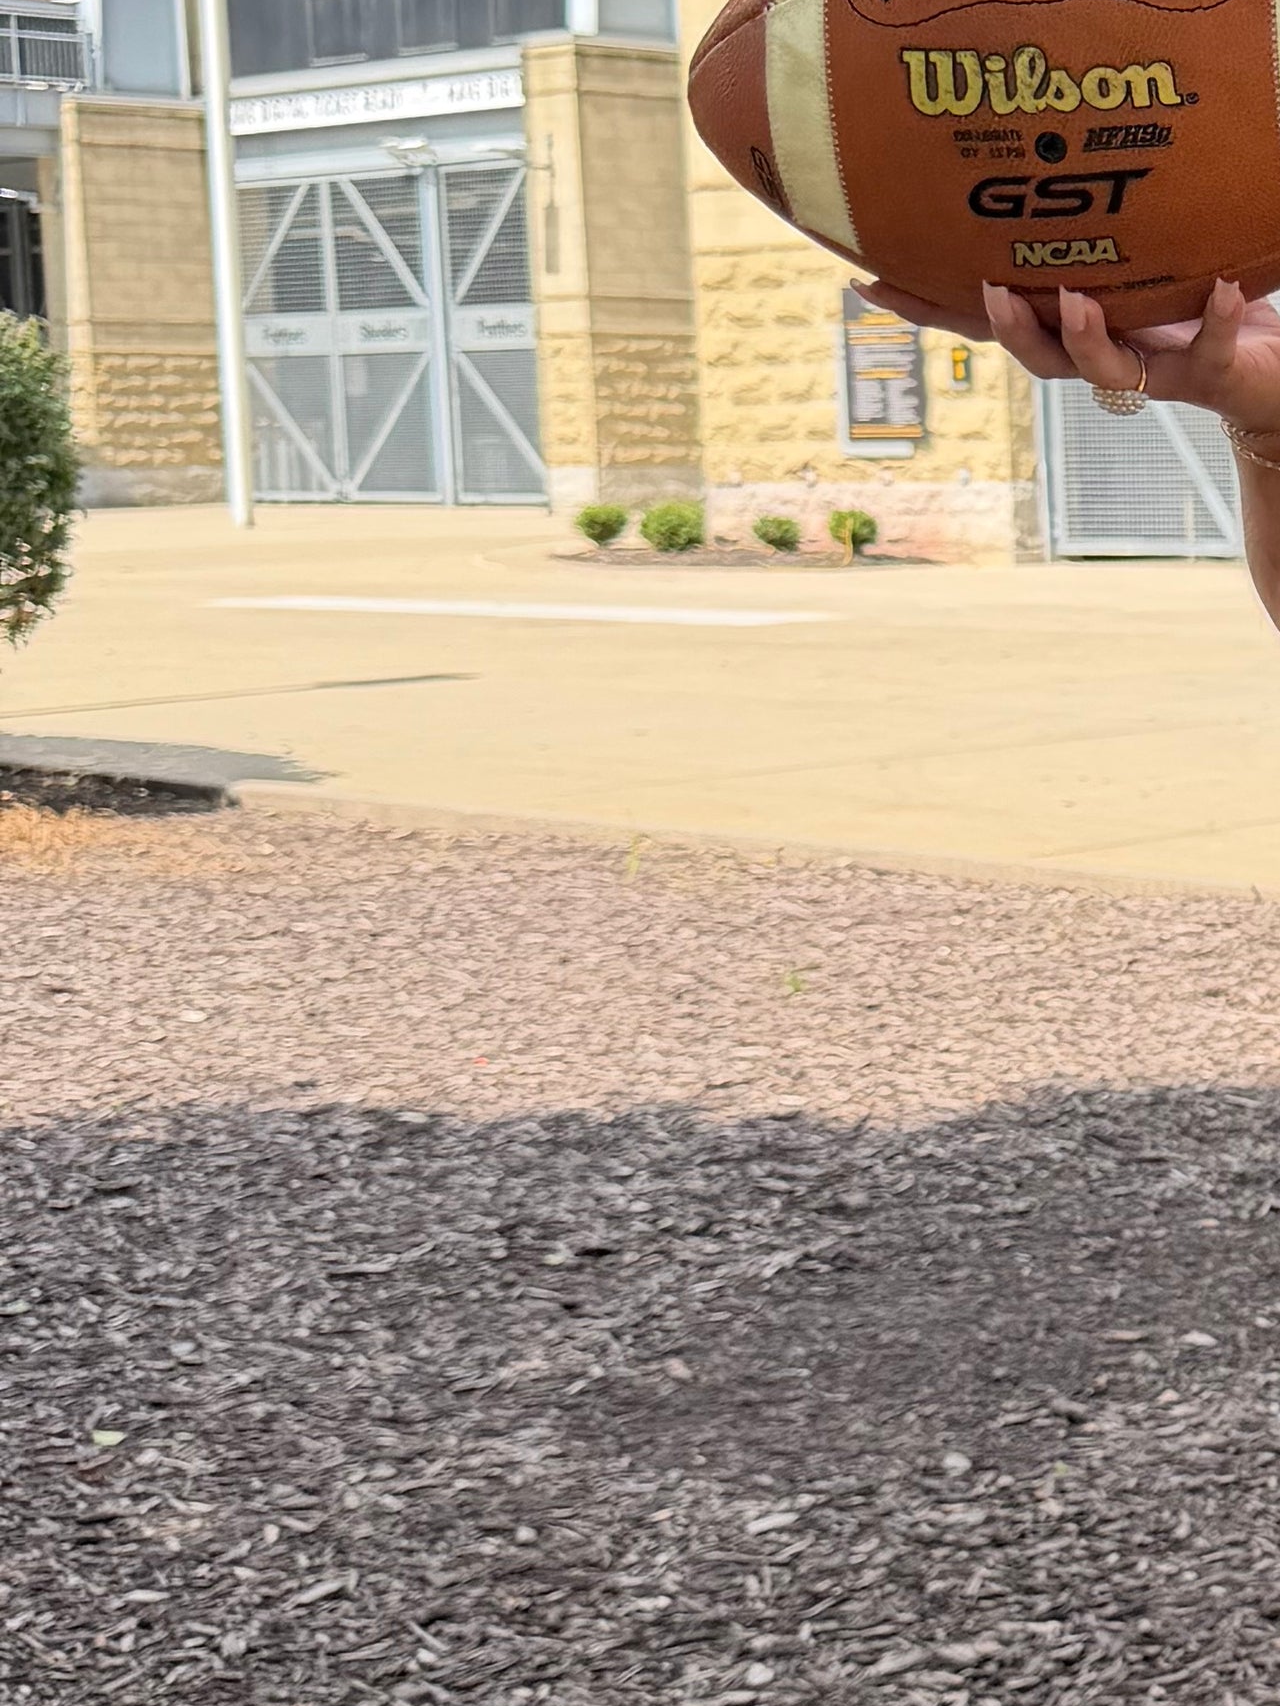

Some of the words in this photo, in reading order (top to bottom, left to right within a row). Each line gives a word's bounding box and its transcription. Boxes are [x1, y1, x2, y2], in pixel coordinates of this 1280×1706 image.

[901, 45, 1183, 118] Wilson
[967, 167, 1155, 220] GST
[1012, 236, 1120, 268] NCAA
